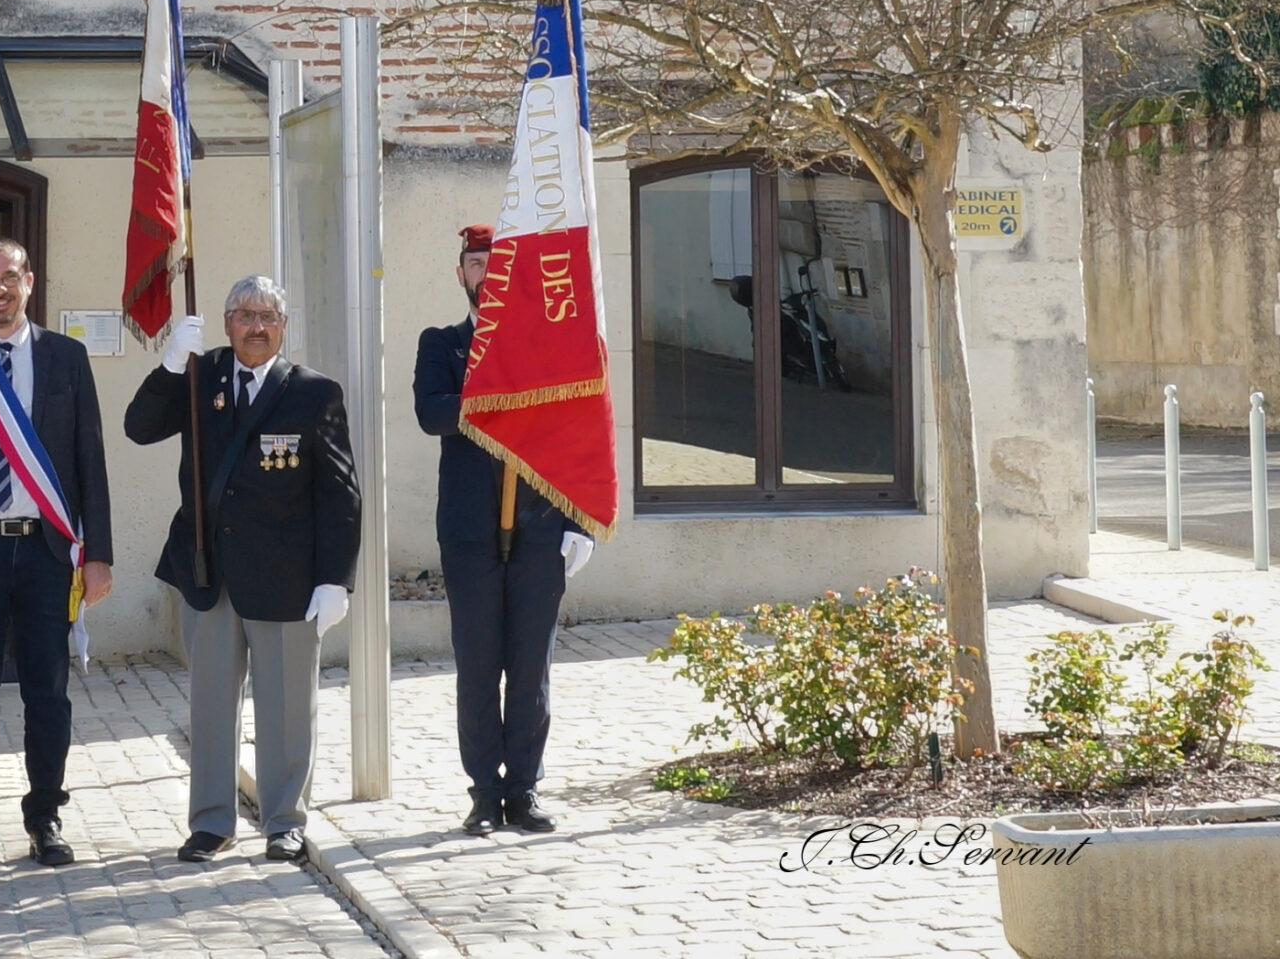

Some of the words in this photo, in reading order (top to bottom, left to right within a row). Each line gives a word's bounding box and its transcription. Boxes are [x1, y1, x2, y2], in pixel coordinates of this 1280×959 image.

[525, 16, 569, 236] SSOCIATION
[957, 190, 1018, 201] ABINET
[955, 205, 1020, 215] EDICAL
[961, 222, 991, 231] 20m
[539, 249, 578, 323] DES
